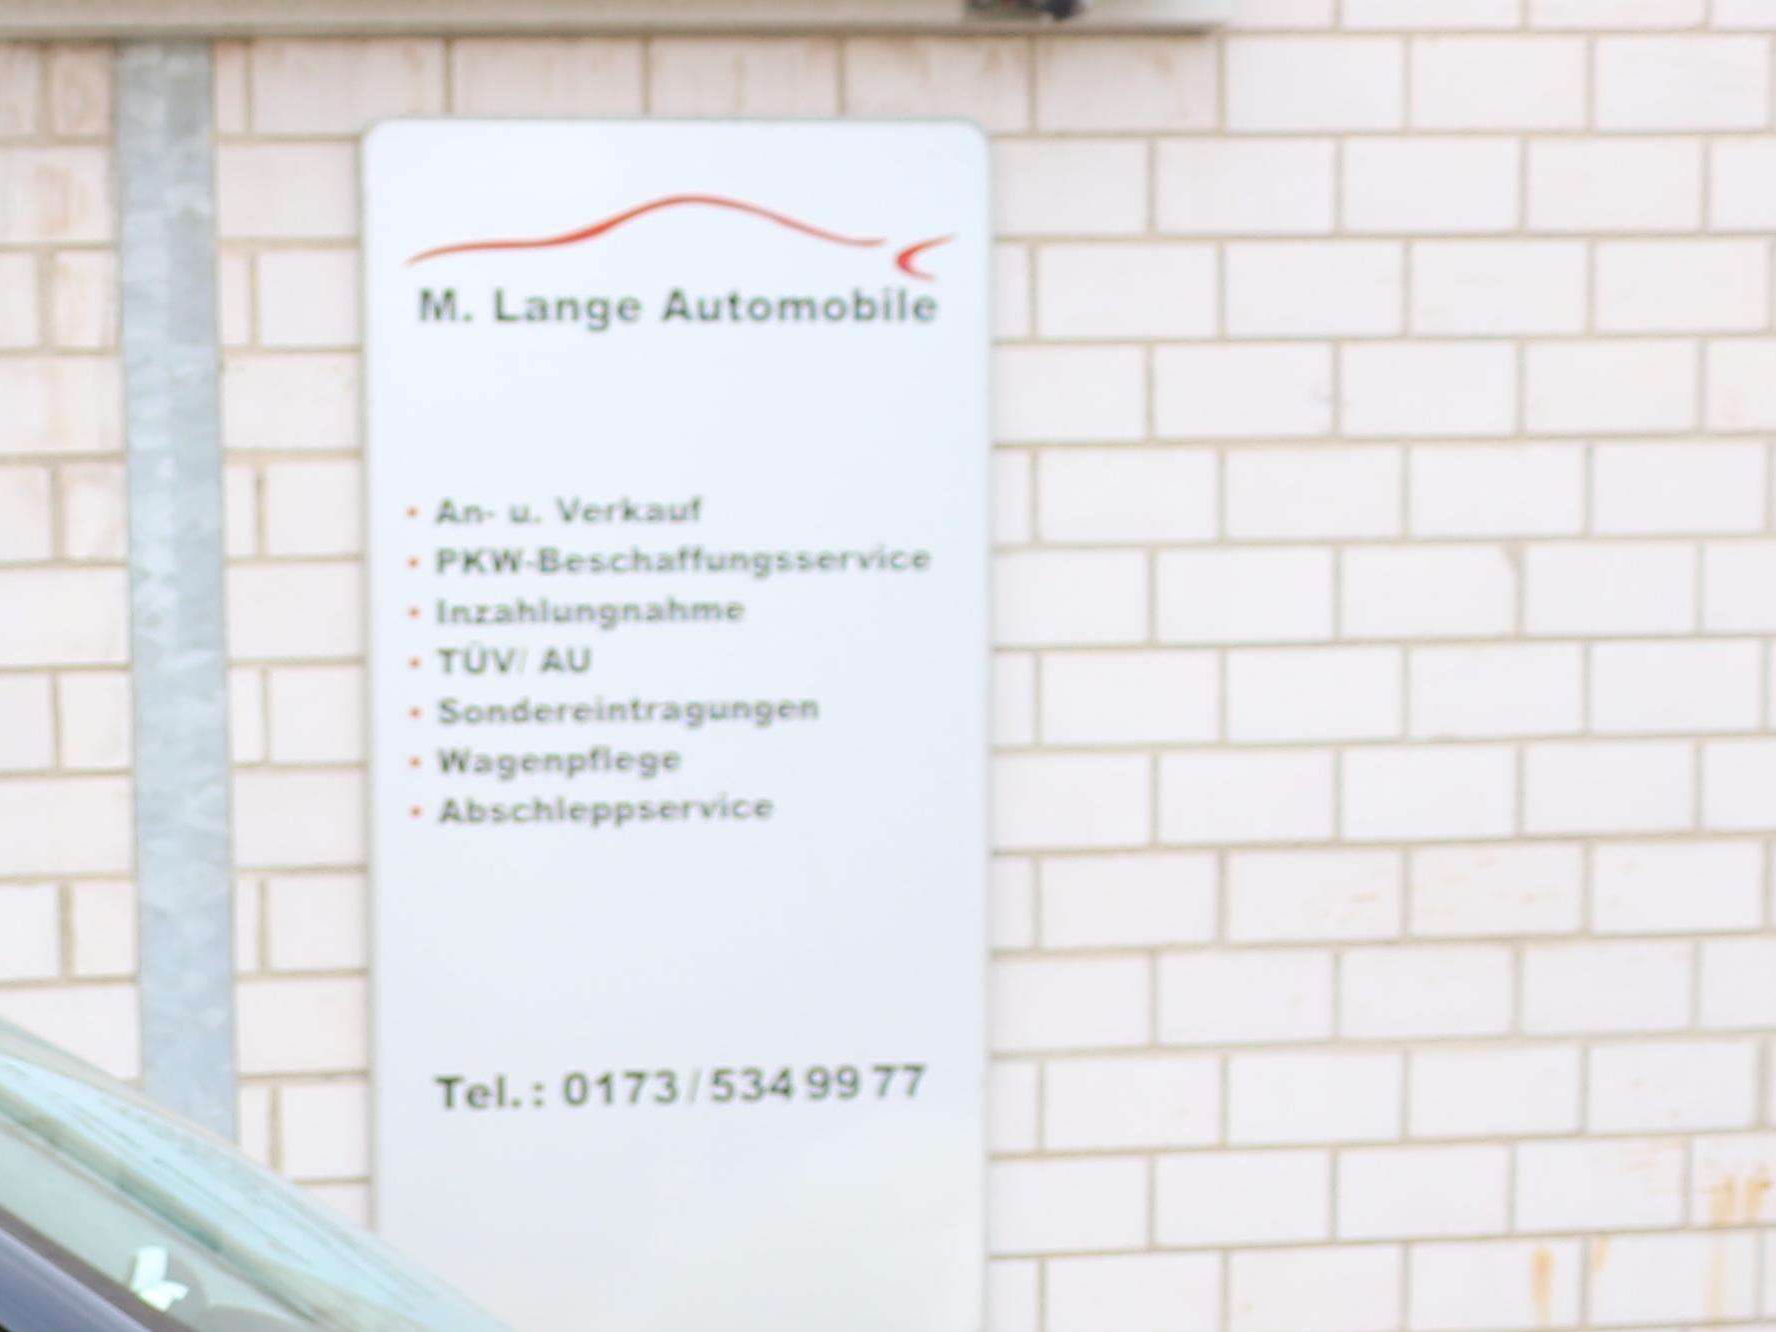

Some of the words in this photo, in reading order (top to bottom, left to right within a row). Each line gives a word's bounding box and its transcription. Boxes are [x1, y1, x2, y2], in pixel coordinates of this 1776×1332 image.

[417, 286, 473, 323] M.
[492, 286, 642, 331] Lange
[661, 285, 938, 323] Automobile
[435, 499, 496, 525] An-
[508, 504, 542, 525] u.
[556, 496, 704, 524] Verkauf
[435, 543, 932, 580] PKW-Beschaffungsservice
[435, 597, 747, 630] Inzahlungnahme
[538, 646, 593, 673] AU
[436, 695, 820, 729] Sondereintragungen
[436, 746, 683, 782] Wagenpflege
[437, 792, 775, 828] Abschleppservice
